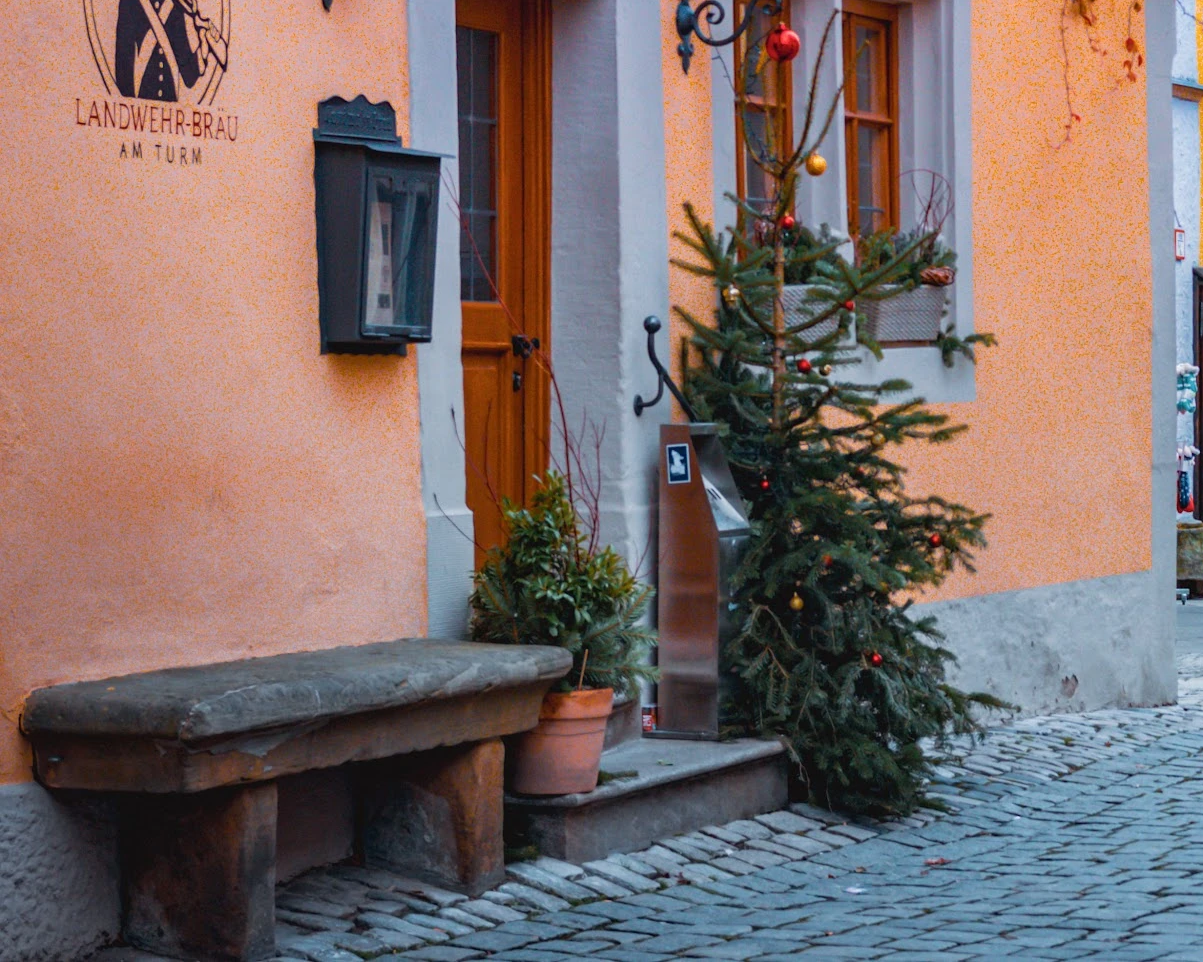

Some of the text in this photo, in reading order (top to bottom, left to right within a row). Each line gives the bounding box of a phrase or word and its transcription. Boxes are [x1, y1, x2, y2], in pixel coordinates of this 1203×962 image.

[75, 98, 239, 142] LANDWEHR-BRÄU
[119, 141, 201, 166] AM TURM
